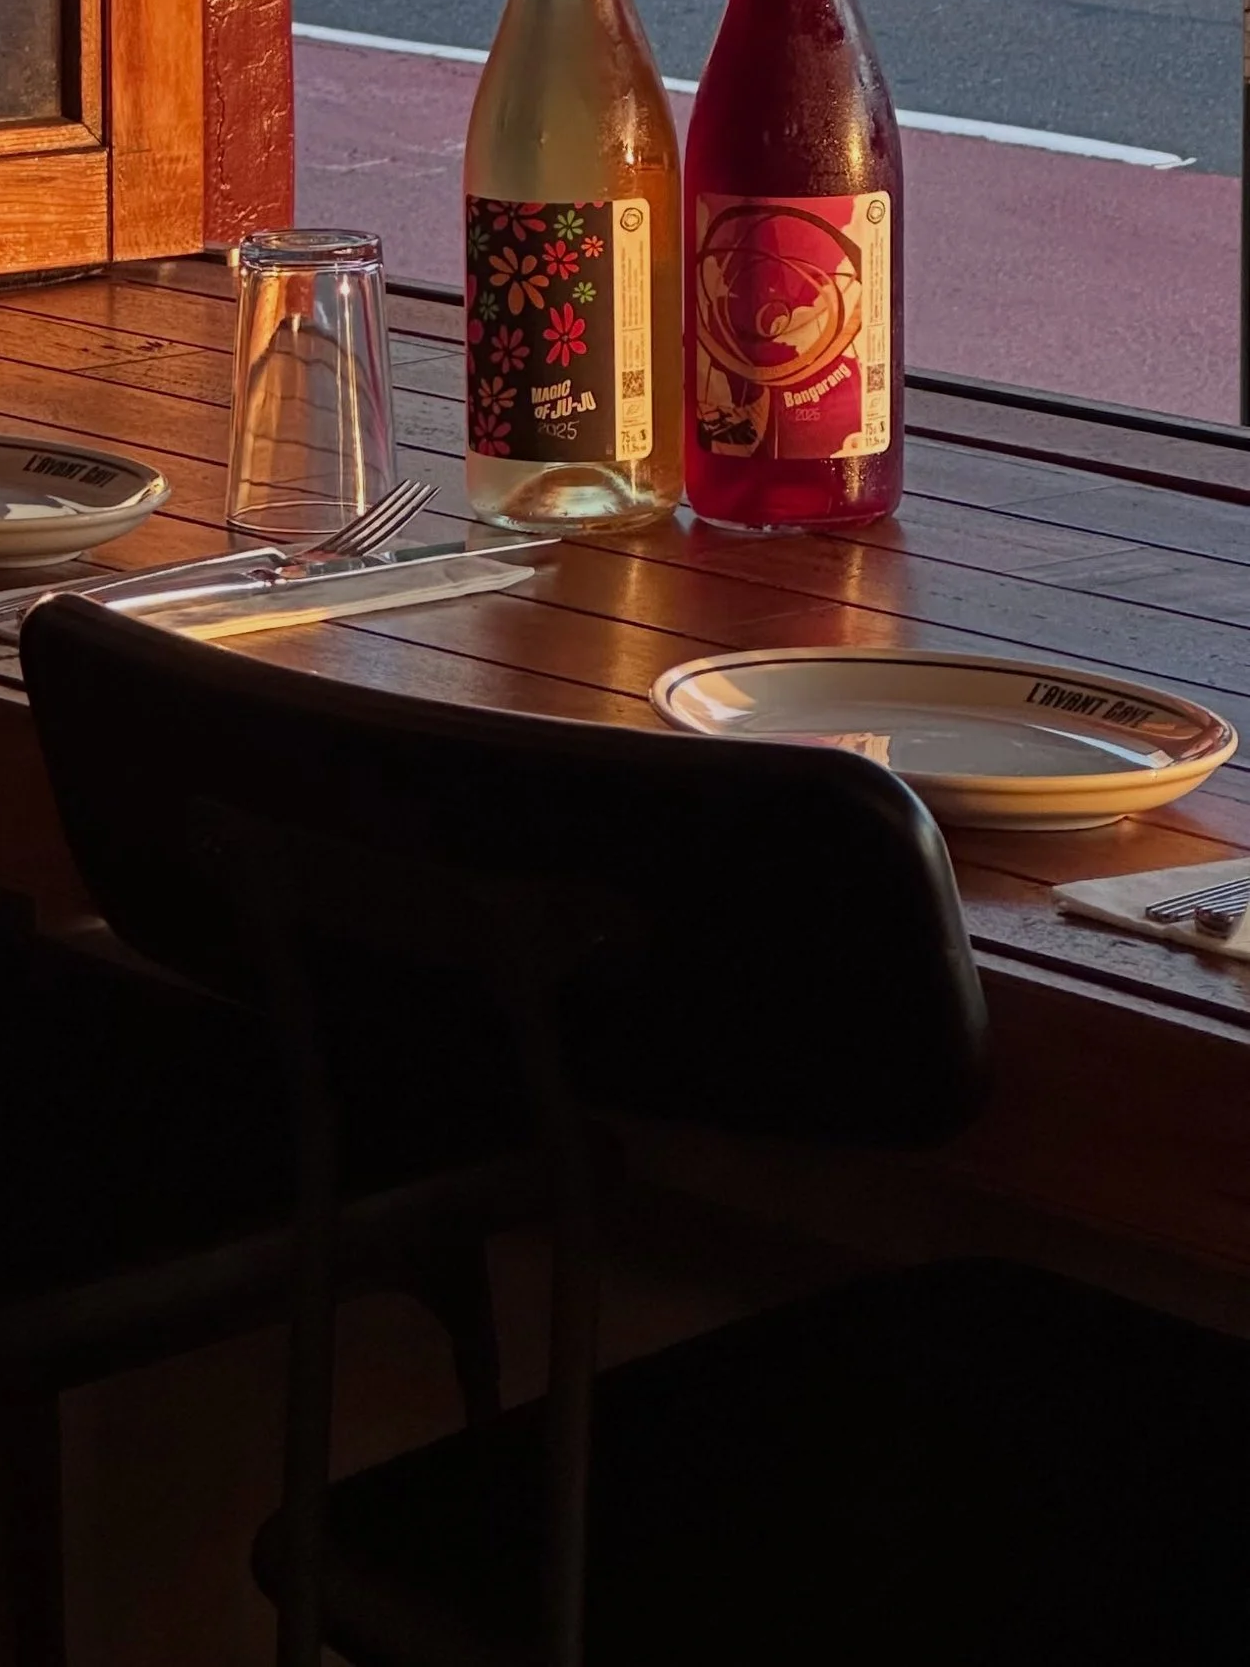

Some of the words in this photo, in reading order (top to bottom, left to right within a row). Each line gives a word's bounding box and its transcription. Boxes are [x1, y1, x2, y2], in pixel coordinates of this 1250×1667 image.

[531, 379, 571, 404] MAGIC
[783, 362, 852, 408] Bangarang
[534, 403, 551, 420] OF
[550, 390, 597, 420] JU-JU
[1025, 682, 1108, 716] L'AVANT
